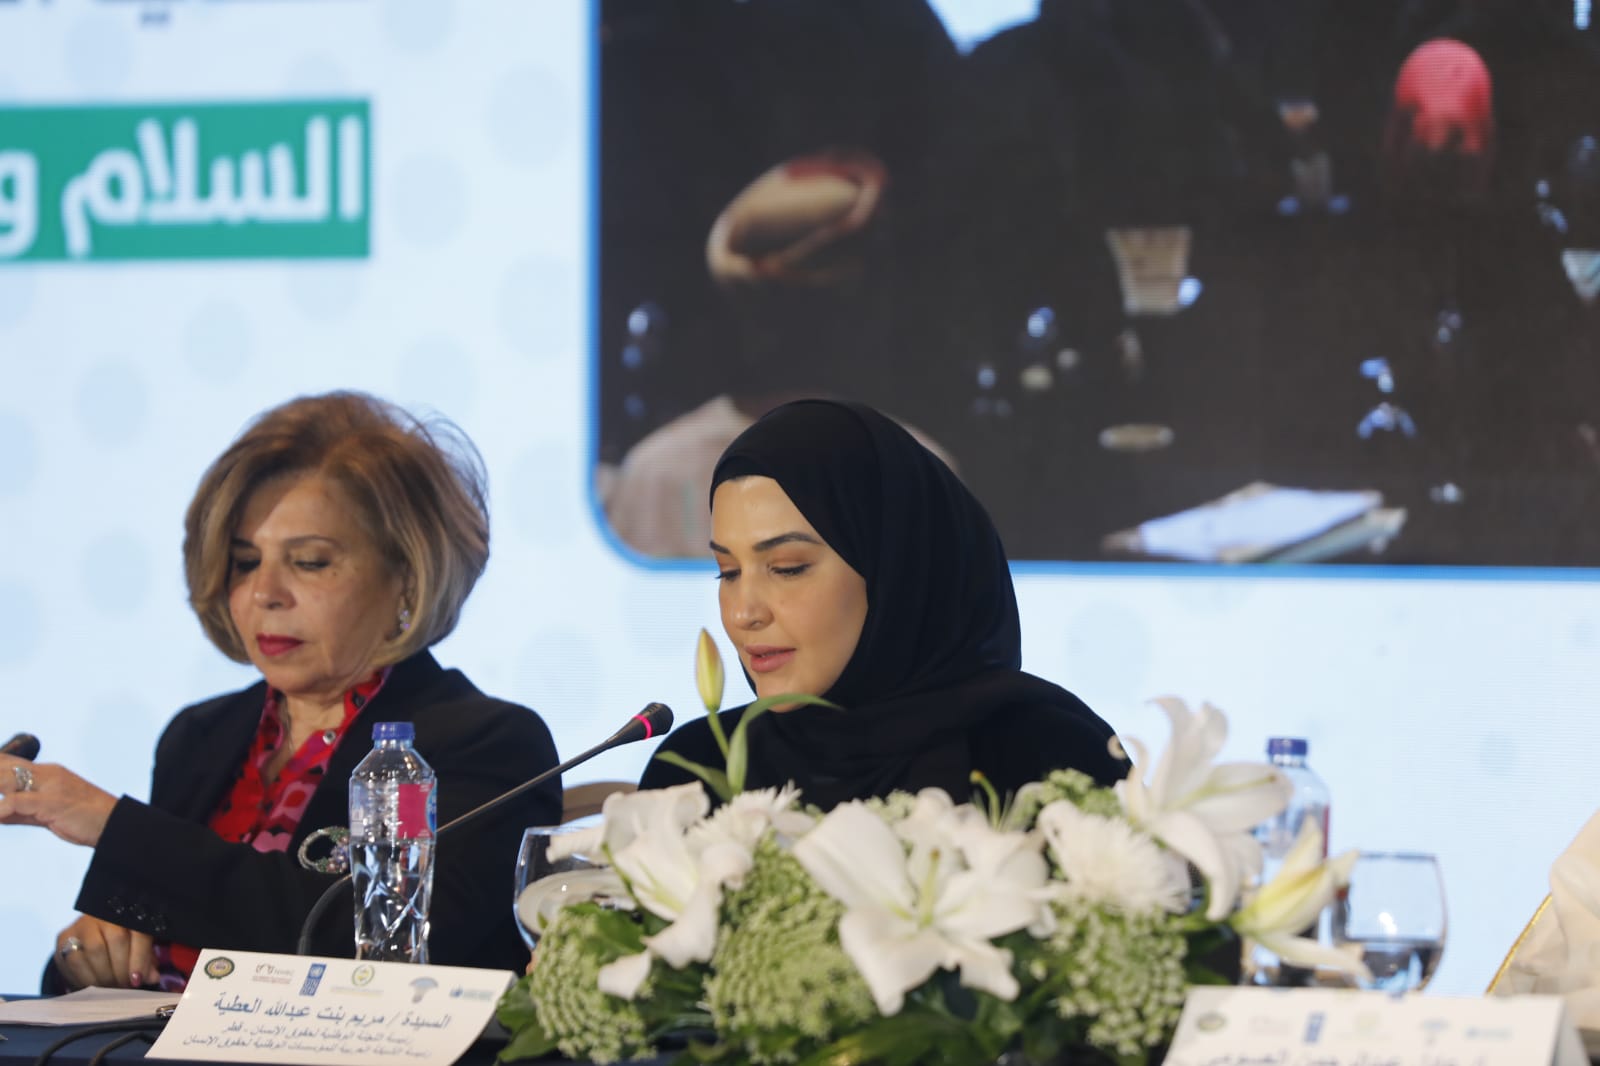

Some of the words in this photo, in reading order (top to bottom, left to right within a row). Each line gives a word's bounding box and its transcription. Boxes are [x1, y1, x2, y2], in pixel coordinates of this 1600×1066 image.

[61, 115, 364, 260] السلام
[213, 992, 263, 1017] العطية
[316, 1006, 345, 1024] بنت
[346, 1013, 385, 1027] مريم
[401, 1011, 452, 1031] السيدة
